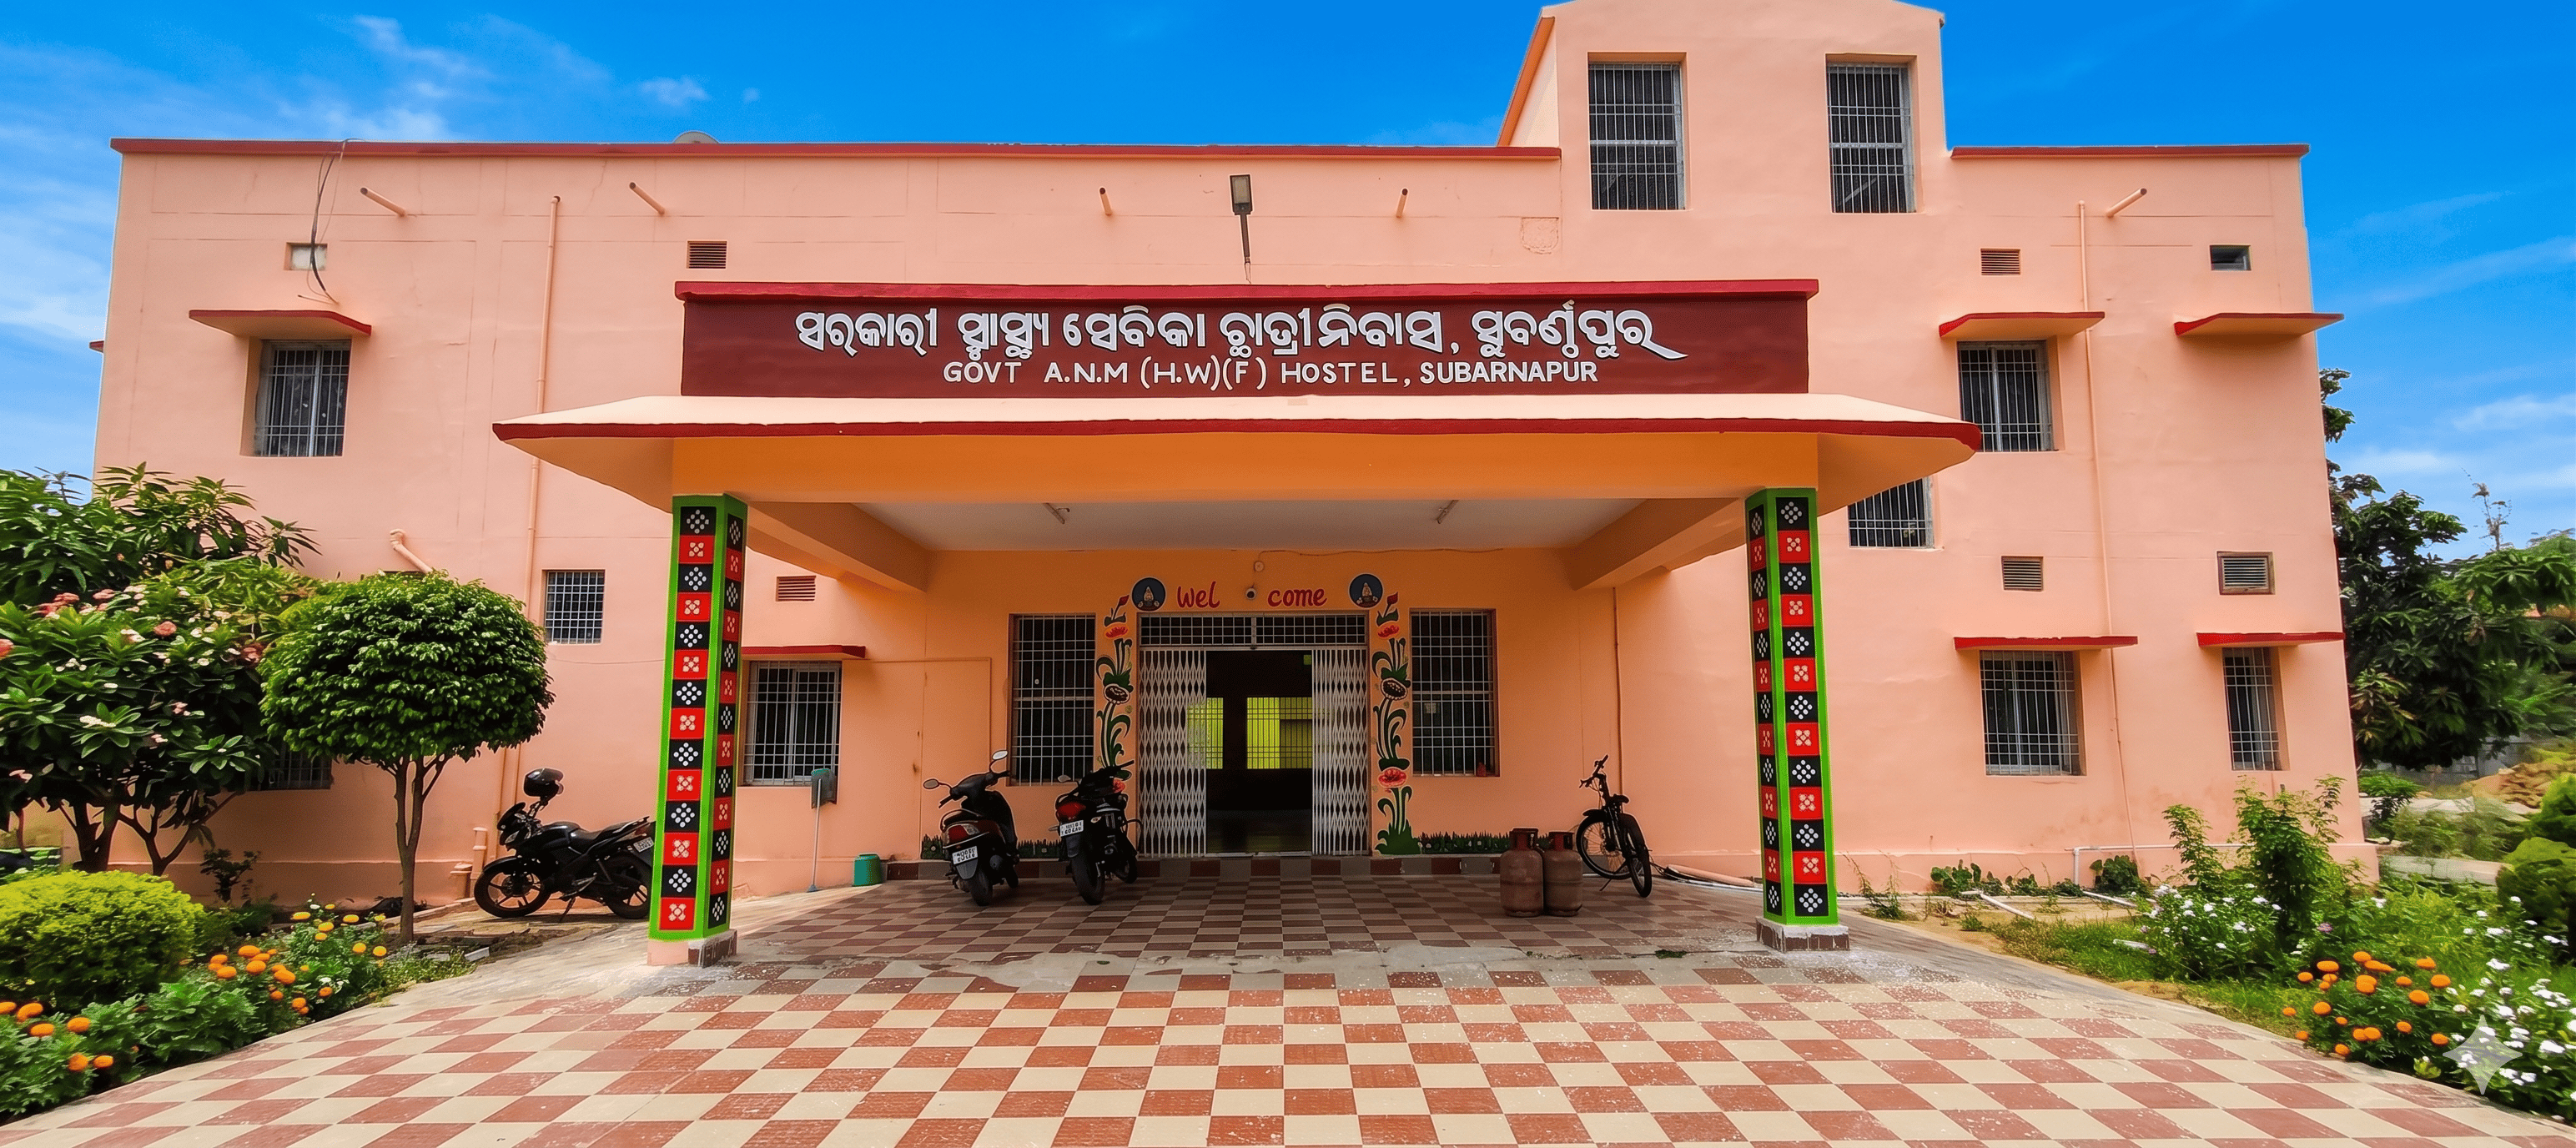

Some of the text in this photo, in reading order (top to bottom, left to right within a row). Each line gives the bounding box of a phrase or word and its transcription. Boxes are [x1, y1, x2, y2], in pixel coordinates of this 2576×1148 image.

[795, 308, 938, 357] ସରକାରୀ
[1063, 305, 1205, 351] ସେବିକା
[943, 361, 1022, 383] GOVT
[1044, 362, 1128, 383] A.N.M
[1281, 362, 1411, 388] HOSTEL,
[1420, 361, 1598, 384] SUBARNAPUR
[1267, 588, 1328, 607] come
